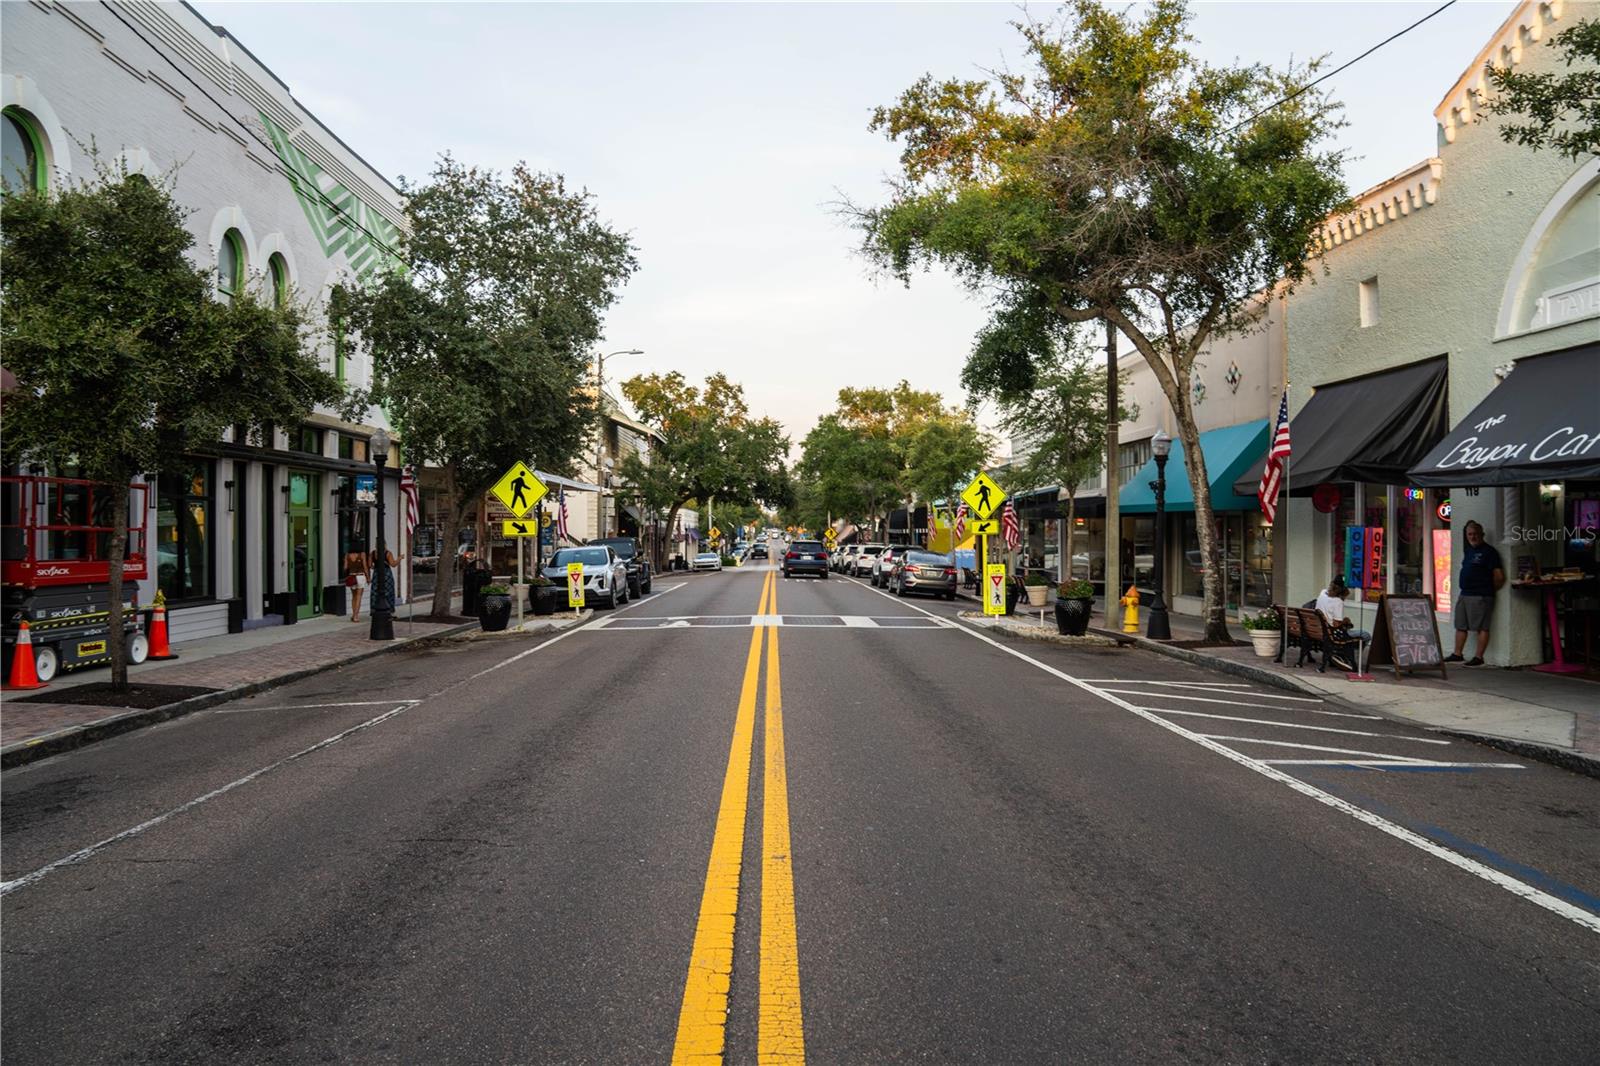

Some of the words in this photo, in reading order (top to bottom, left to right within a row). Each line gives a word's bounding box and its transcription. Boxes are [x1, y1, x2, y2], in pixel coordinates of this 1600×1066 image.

[1475, 414, 1507, 432] The
[1436, 437, 1527, 469] Bayou
[1465, 487, 1479, 496] 118
[1352, 531, 1362, 581] OPEN
[37, 566, 70, 576] SKYJACK
